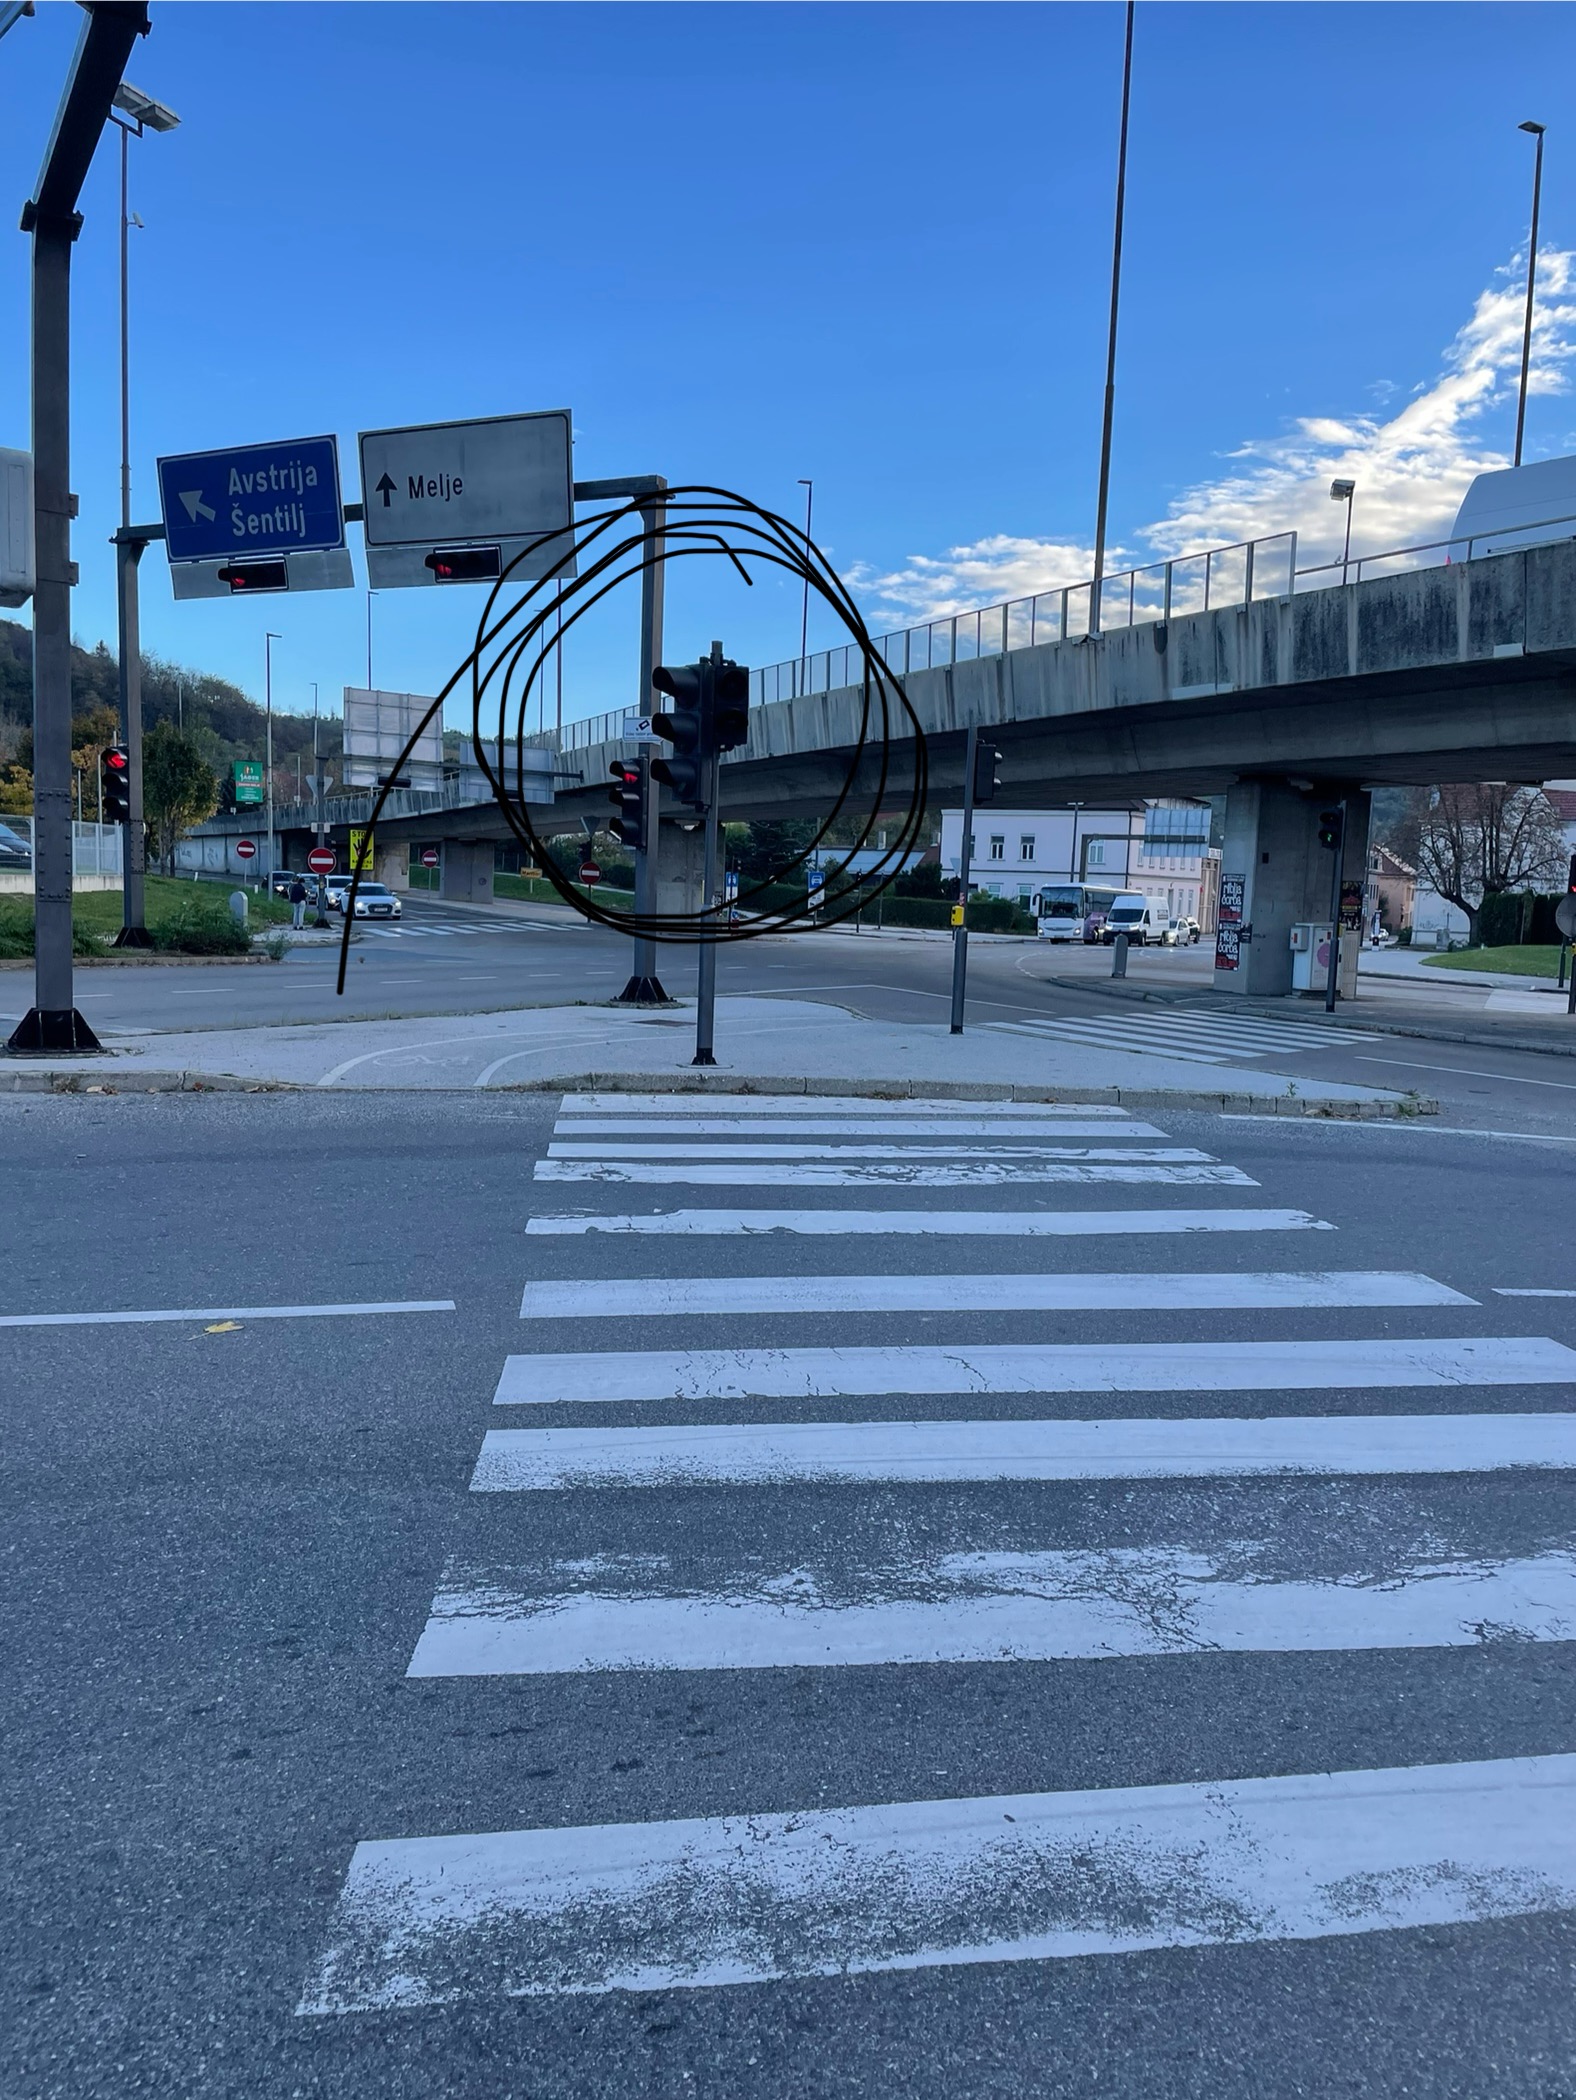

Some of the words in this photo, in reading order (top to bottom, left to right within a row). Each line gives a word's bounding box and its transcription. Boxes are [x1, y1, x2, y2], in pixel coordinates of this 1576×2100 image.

[228, 459, 318, 496] Avstrija
[408, 473, 463, 502] Melje
[231, 502, 306, 538] Šentilj
